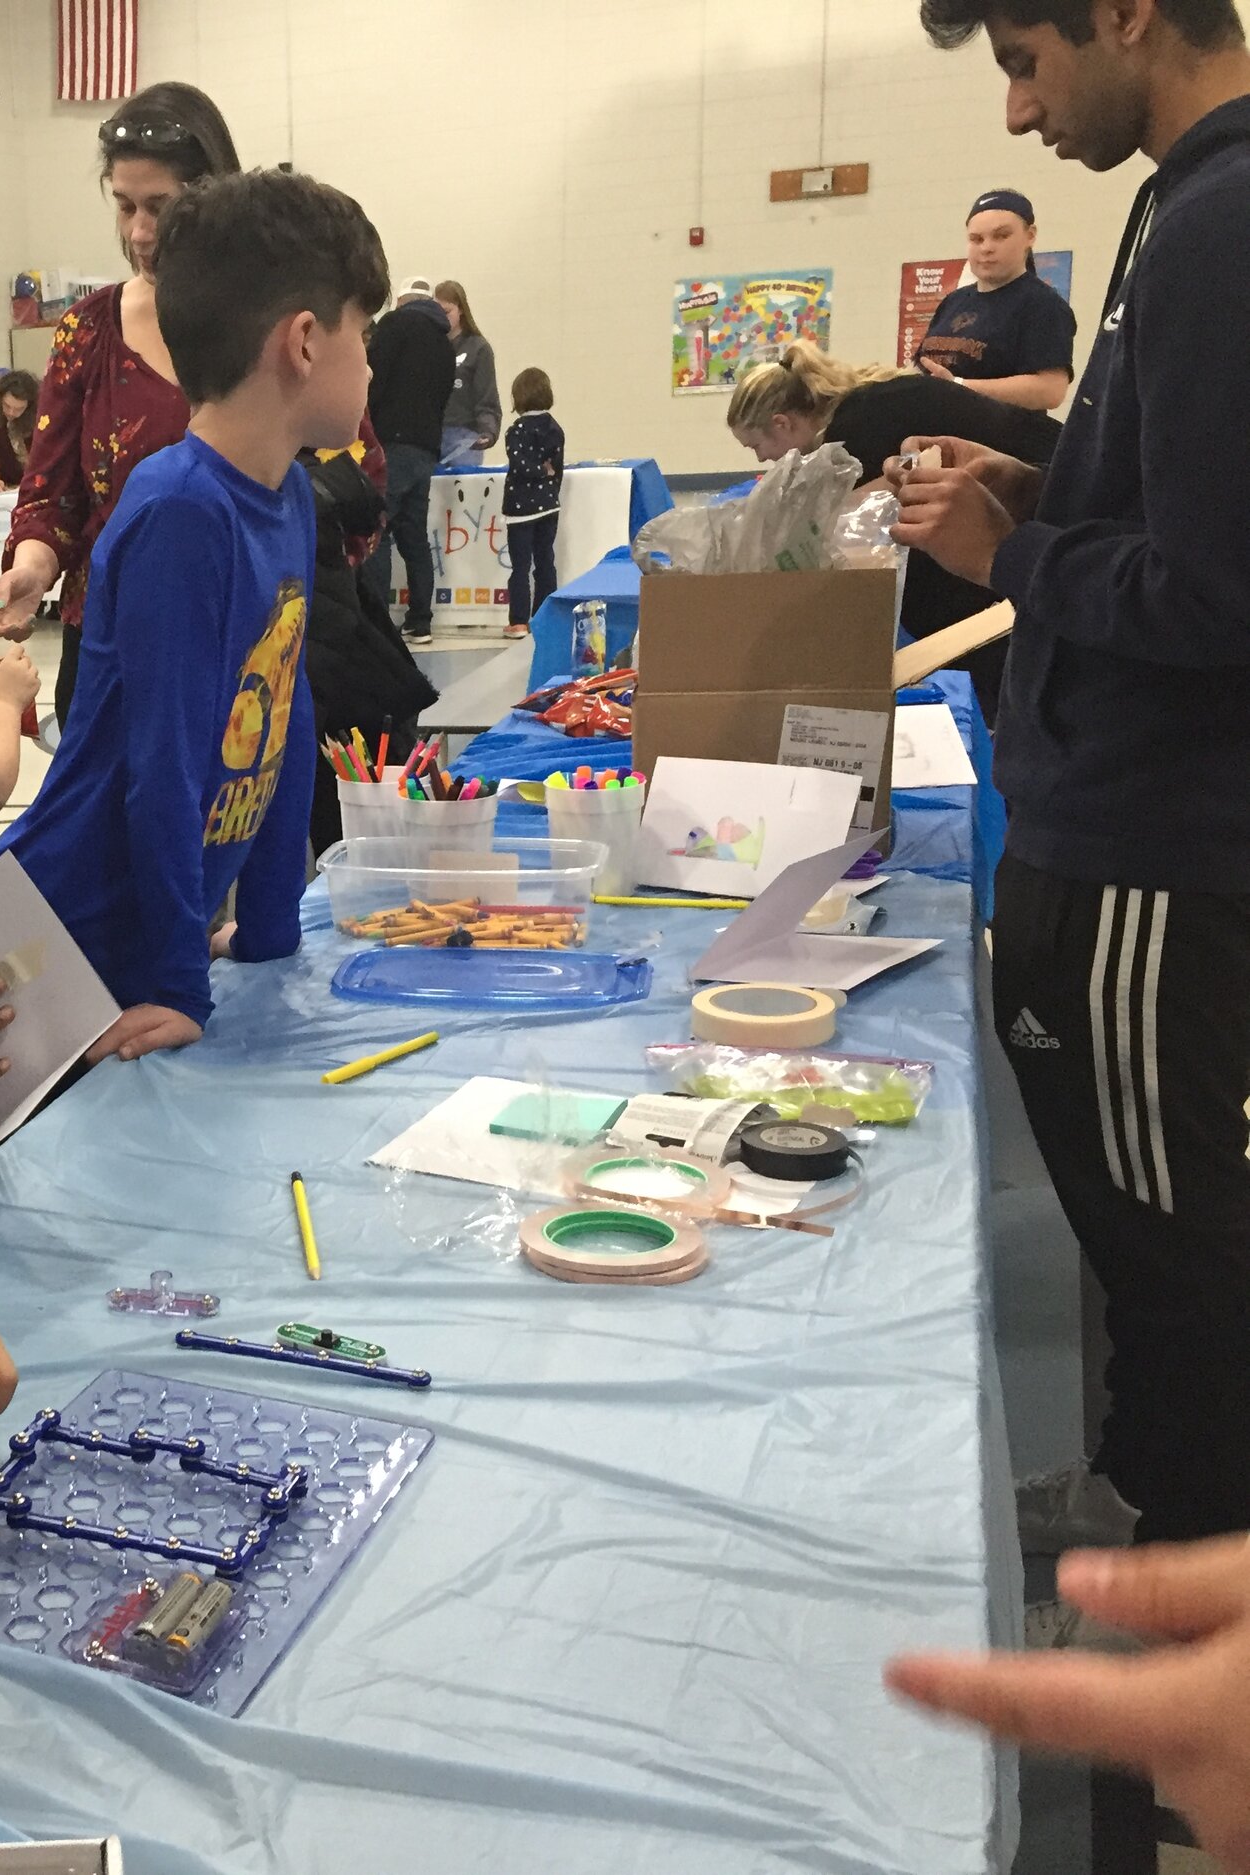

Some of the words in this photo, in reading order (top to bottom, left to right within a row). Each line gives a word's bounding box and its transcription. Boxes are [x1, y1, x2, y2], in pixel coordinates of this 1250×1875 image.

[916, 267, 944, 277] Know
[919, 275, 942, 285] Your
[746, 283, 771, 294] HAPPY
[915, 284, 943, 294] Heart
